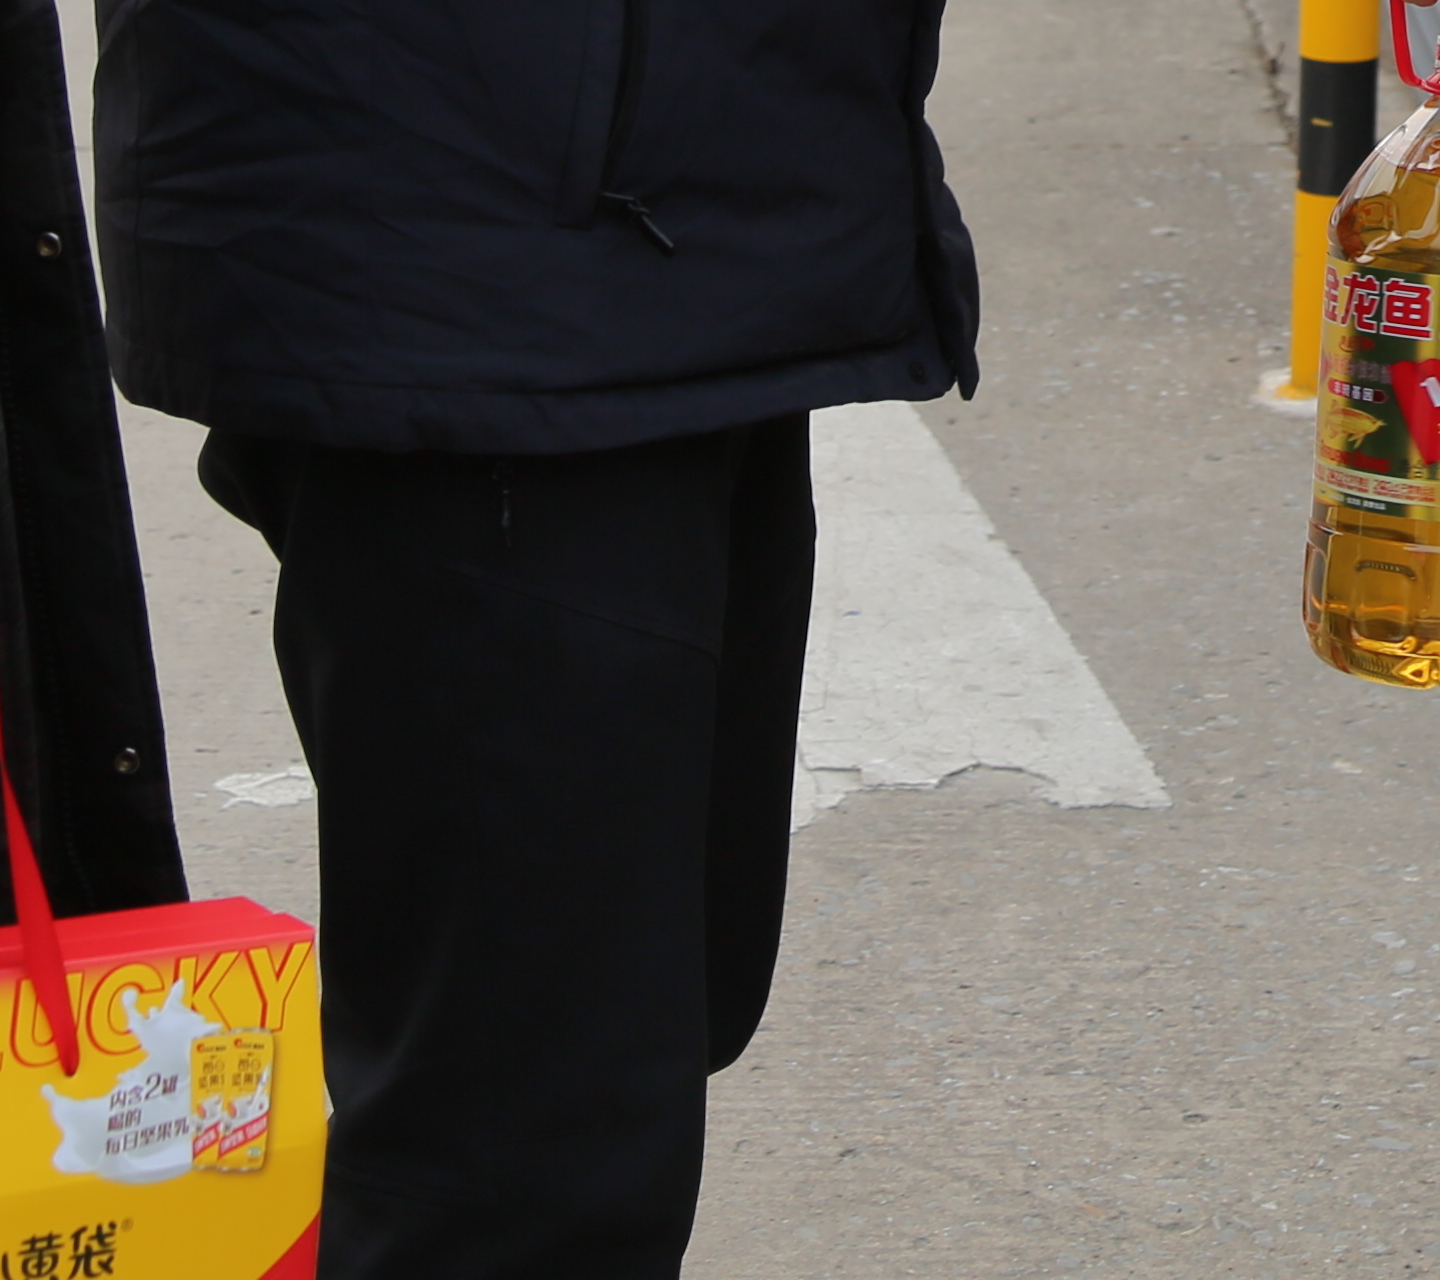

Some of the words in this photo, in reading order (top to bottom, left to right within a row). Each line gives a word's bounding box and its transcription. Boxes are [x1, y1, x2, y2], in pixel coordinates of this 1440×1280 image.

[105, 1117, 190, 1155] 每日坚果乳
